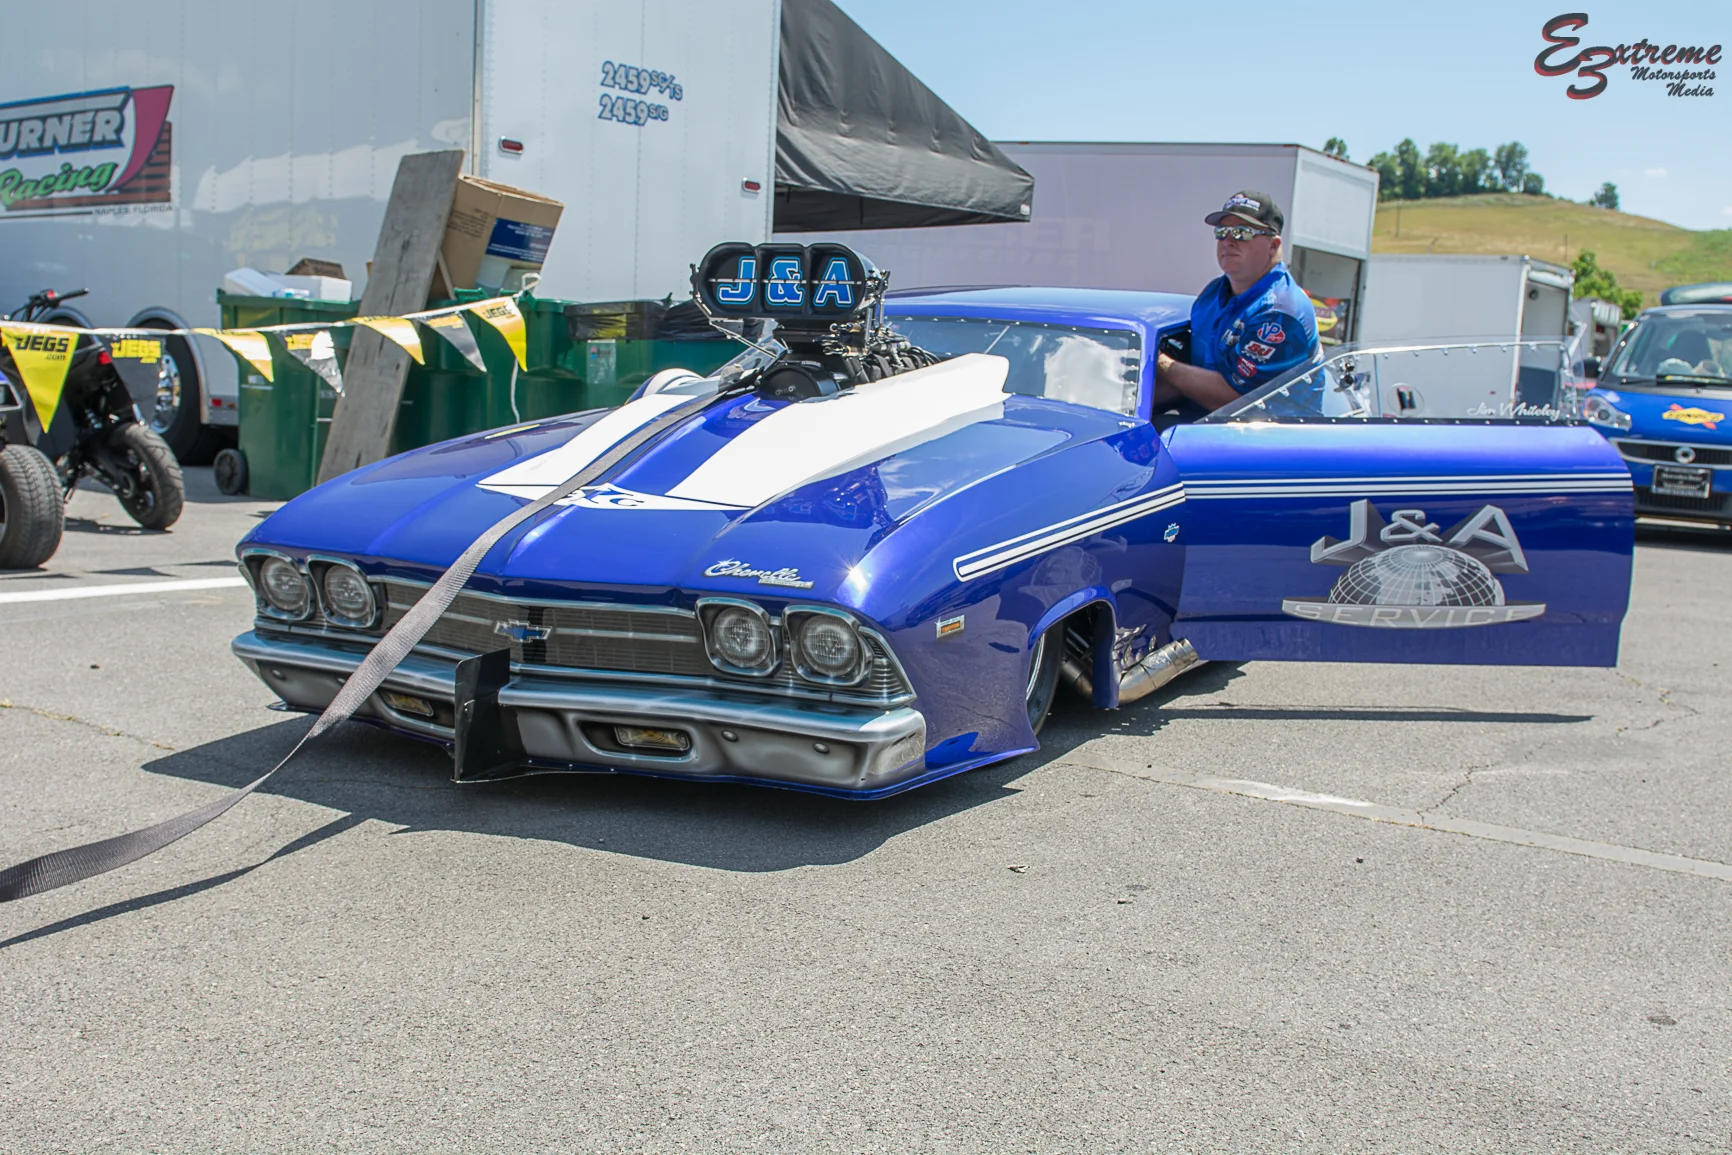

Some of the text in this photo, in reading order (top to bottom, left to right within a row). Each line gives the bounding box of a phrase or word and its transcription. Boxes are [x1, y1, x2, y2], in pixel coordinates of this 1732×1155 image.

[0, 162, 118, 206] Racing
[16, 335, 69, 352] JEGS
[111, 339, 161, 358] JEGS
[1500, 402, 1560, 421] Whiteley
[1292, 604, 1537, 627] SERVICE
